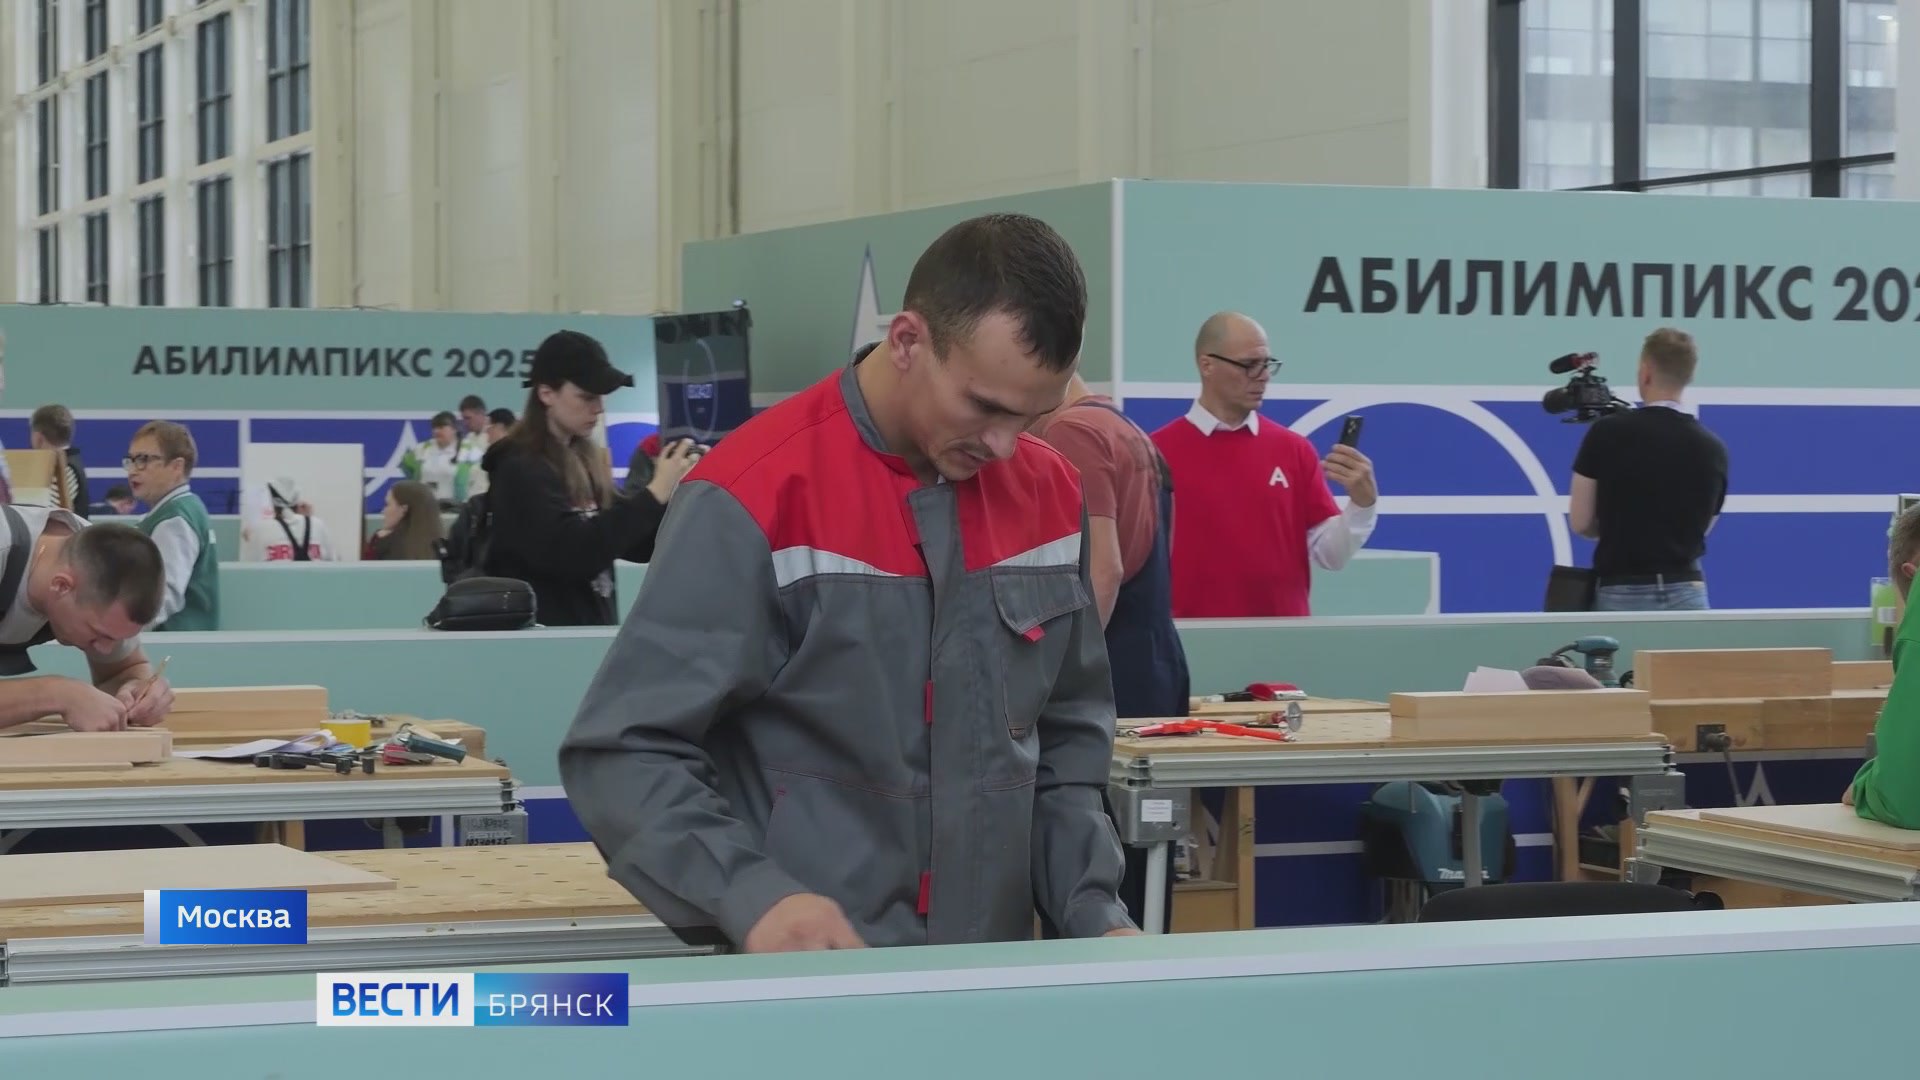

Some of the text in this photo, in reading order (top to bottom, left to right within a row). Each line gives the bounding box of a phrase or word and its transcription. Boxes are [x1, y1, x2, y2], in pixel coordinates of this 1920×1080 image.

[1304, 256, 1920, 323] АБИЛИМПИКС 20
[132, 345, 537, 378] АБИЛИМПИКС 2025
